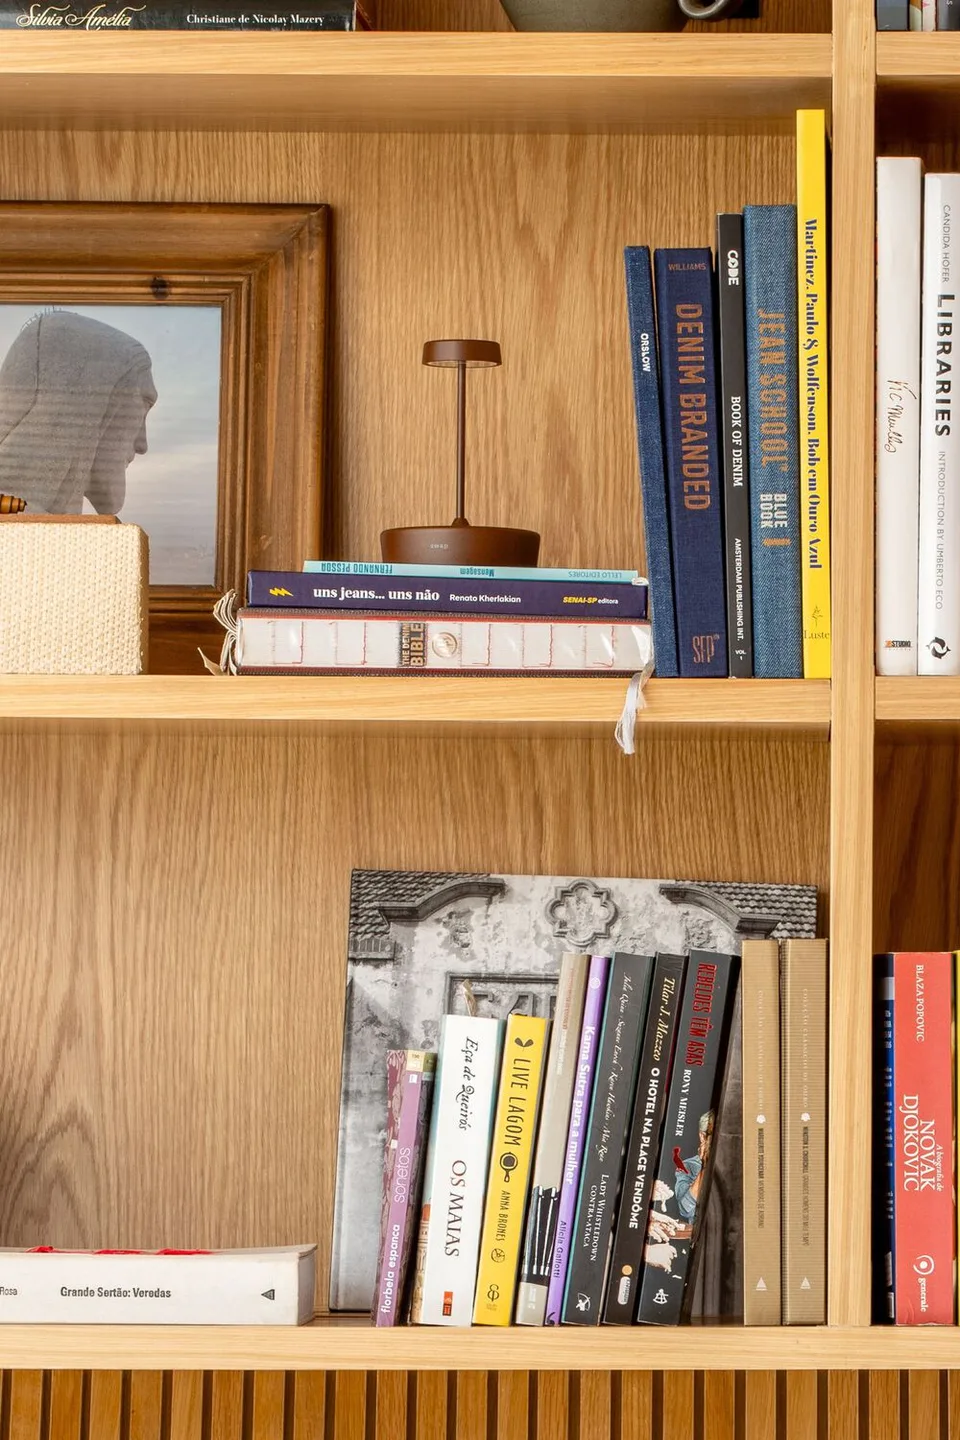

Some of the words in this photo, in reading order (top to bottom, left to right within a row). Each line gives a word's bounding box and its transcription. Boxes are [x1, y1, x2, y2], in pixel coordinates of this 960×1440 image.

[16, 4, 69, 27] Silvia
[65, 4, 147, 31] Amélia
[186, 13, 237, 25] Christiane
[238, 13, 250, 25] de
[251, 13, 288, 27] Nicolay
[289, 13, 325, 27] Mazery
[941, 204, 951, 250] CANDIDA
[667, 262, 707, 271] WILLIAMS
[726, 249, 740, 286] CODE
[804, 292, 819, 336] Paulo
[640, 332, 652, 372] ORSLOW
[674, 303, 707, 385] DENIM
[757, 308, 786, 364] JEAN
[803, 338, 819, 351] &
[935, 293, 956, 437] LIBRARIES
[730, 395, 742, 428] BOOK
[679, 392, 711, 511] BRANDED
[731, 430, 743, 446] OF
[807, 437, 821, 467] Bob
[732, 448, 744, 488] DENIM
[807, 468, 818, 492] em
[936, 450, 946, 526] INTRODUCTION
[760, 492, 773, 529] BOOK
[773, 492, 788, 529] BLUE
[807, 494, 821, 533] Ouro
[936, 528, 945, 541] BY
[321, 561, 351, 574] PESSOA
[353, 562, 393, 575] FERNANDO
[733, 537, 743, 586] AMSTERDAM
[808, 536, 823, 570] Azul
[935, 543, 945, 588] UMBERTO
[459, 566, 496, 577] Mensagem
[312, 587, 338, 599] uns
[338, 587, 386, 602] jeans...
[387, 588, 414, 600] uns
[414, 588, 441, 601] não
[449, 593, 478, 603] Renato
[479, 593, 521, 604] Kherlakian
[562, 595, 598, 605] SENAI-SP
[597, 596, 619, 605] editora
[735, 586, 744, 627] PUBLISHING
[934, 588, 943, 610] ECO
[401, 623, 410, 649] DENIM
[410, 623, 424, 666] BIBLE
[736, 628, 745, 641] INT.
[401, 650, 410, 666] THE
[660, 977, 676, 1004] Tilar
[691, 962, 718, 1013] REBELDES
[915, 964, 925, 997] BLAZA
[658, 1005, 671, 1016] J.
[688, 1015, 713, 1038] TÊM
[915, 997, 925, 1042] POPOVIC
[461, 1036, 479, 1063] Eça
[580, 1025, 596, 1062] Kama
[651, 1018, 669, 1062] Mazzeo
[684, 1040, 708, 1066] ASAS
[461, 1065, 477, 1082] de
[509, 1057, 532, 1090] LIVE
[575, 1063, 592, 1098] Sutra
[650, 1067, 660, 1077] O
[679, 1068, 692, 1094] RONY
[455, 1084, 476, 1131] Queirós
[643, 1078, 660, 1116] HOTEL
[503, 1096, 529, 1147] LAGOM
[571, 1099, 587, 1129] para
[641, 1116, 654, 1134] NA
[674, 1096, 690, 1137] MEISLER
[573, 1131, 582, 1140] a
[898, 1094, 920, 1193] DJOKOVIC
[565, 1141, 583, 1185] mulher
[636, 1135, 652, 1172] PLACE
[919, 1119, 936, 1193] NOVAK
[934, 1150, 944, 1183] biografia
[392, 1146, 411, 1204] sonetos
[450, 1159, 468, 1188] OS
[597, 1173, 610, 1197] LADY
[936, 1183, 944, 1192] de
[498, 1190, 511, 1211] ANNA
[627, 1173, 647, 1229] VENDÔME
[443, 1191, 465, 1258] MAIAS
[494, 1212, 509, 1242] BRONES
[556, 1220, 568, 1245] Alicia
[589, 1199, 607, 1261] WHISTLEDOWN
[380, 1271, 396, 1314] florbela
[388, 1224, 402, 1268] espanca
[552, 1246, 565, 1279] Gallotti
[60, 1286, 95, 1299] Grande
[96, 1286, 132, 1299] Sertão:
[132, 1286, 172, 1299] Veredas
